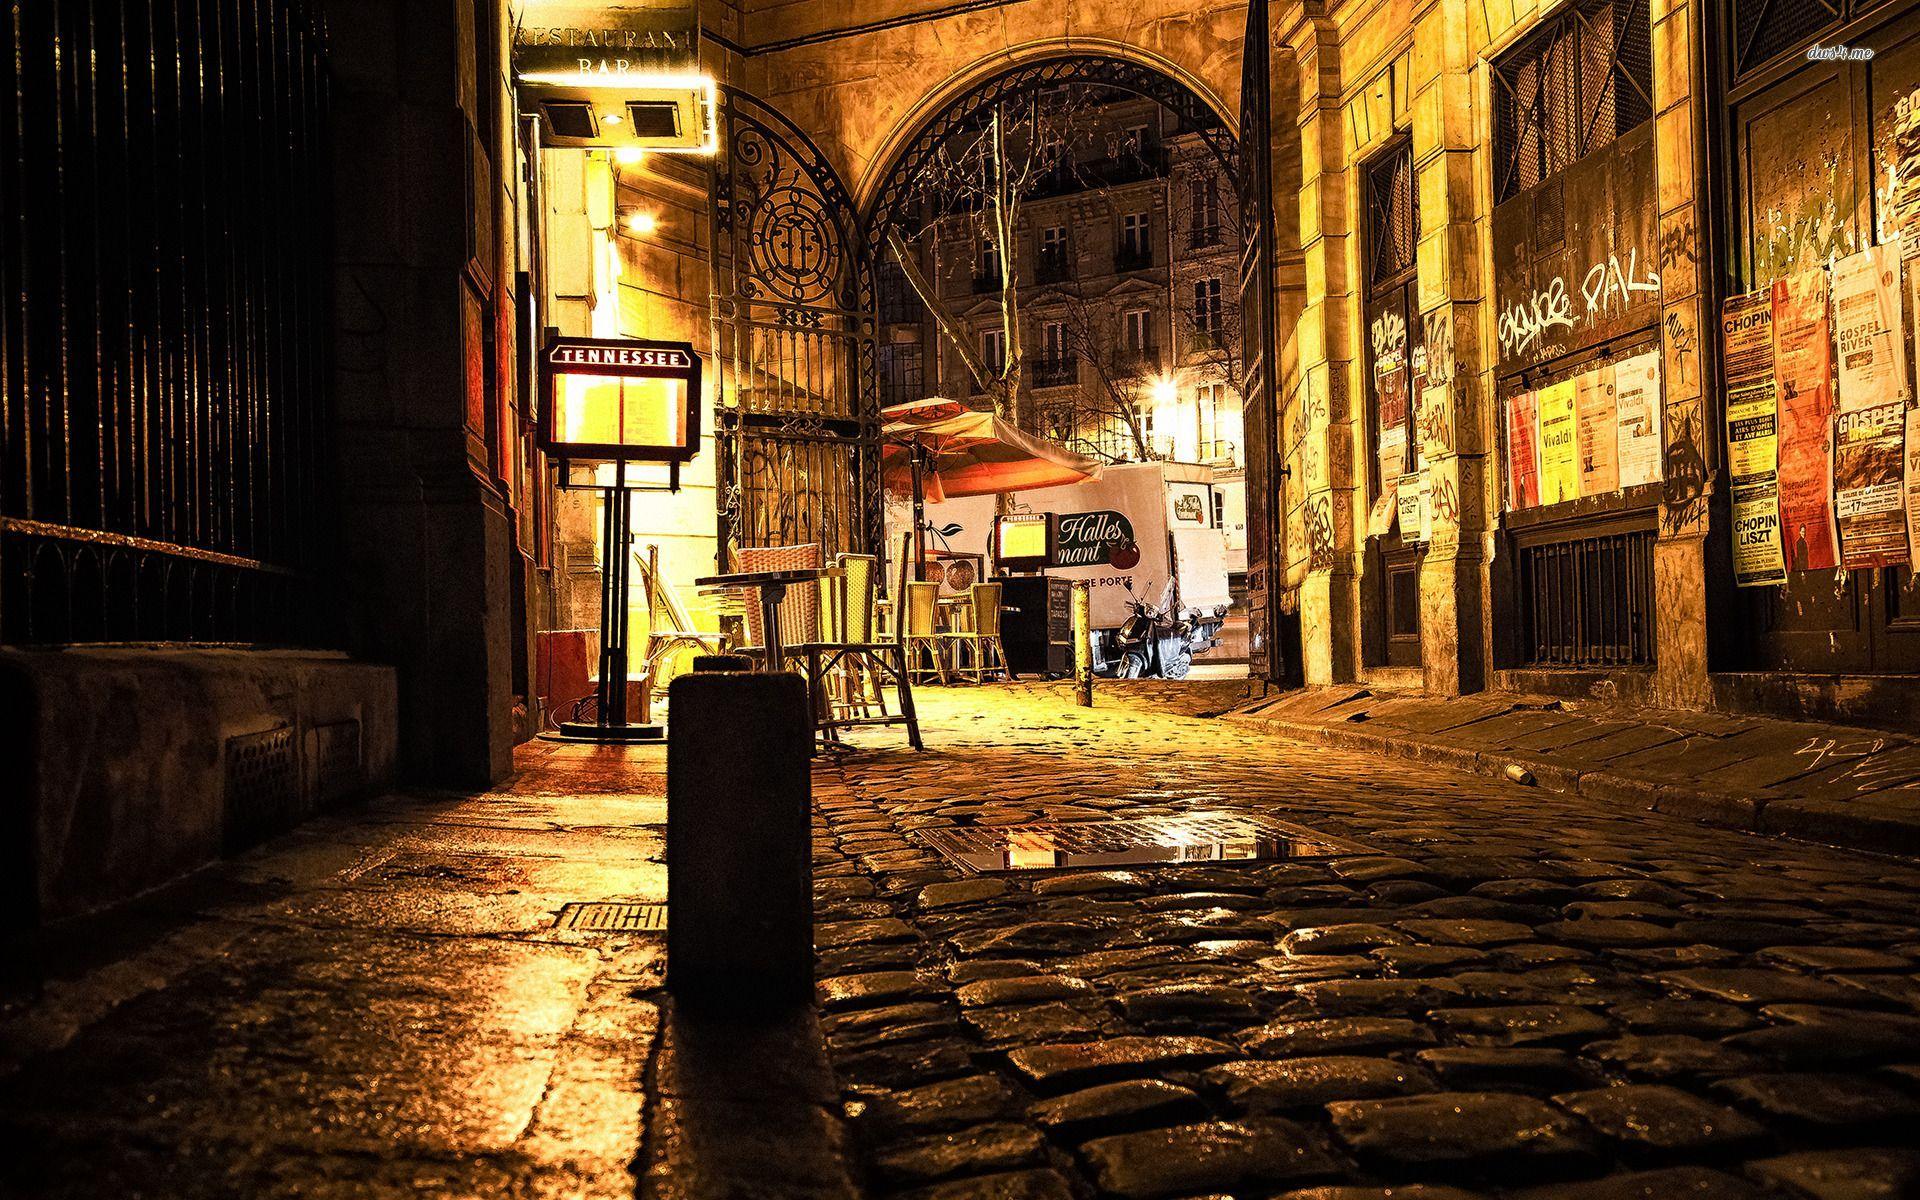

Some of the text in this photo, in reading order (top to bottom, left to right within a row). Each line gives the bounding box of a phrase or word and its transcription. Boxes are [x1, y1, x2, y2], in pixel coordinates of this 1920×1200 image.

[577, 58, 630, 76] BAR
[1724, 310, 1772, 333] CHOPIN
[1840, 321, 1881, 341] GOSPEL
[1840, 335, 1872, 354] RIVER
[562, 350, 680, 365] TENNESSEE
[1619, 395, 1644, 409] Vivaldi
[1544, 428, 1572, 448] Vivaldi
[1851, 501, 1861, 511] 17
[1059, 514, 1122, 543] Halles
[1734, 514, 1777, 532] CHOPIN
[1740, 529, 1771, 545] LISZT
[1100, 576, 1133, 587] PORTE
